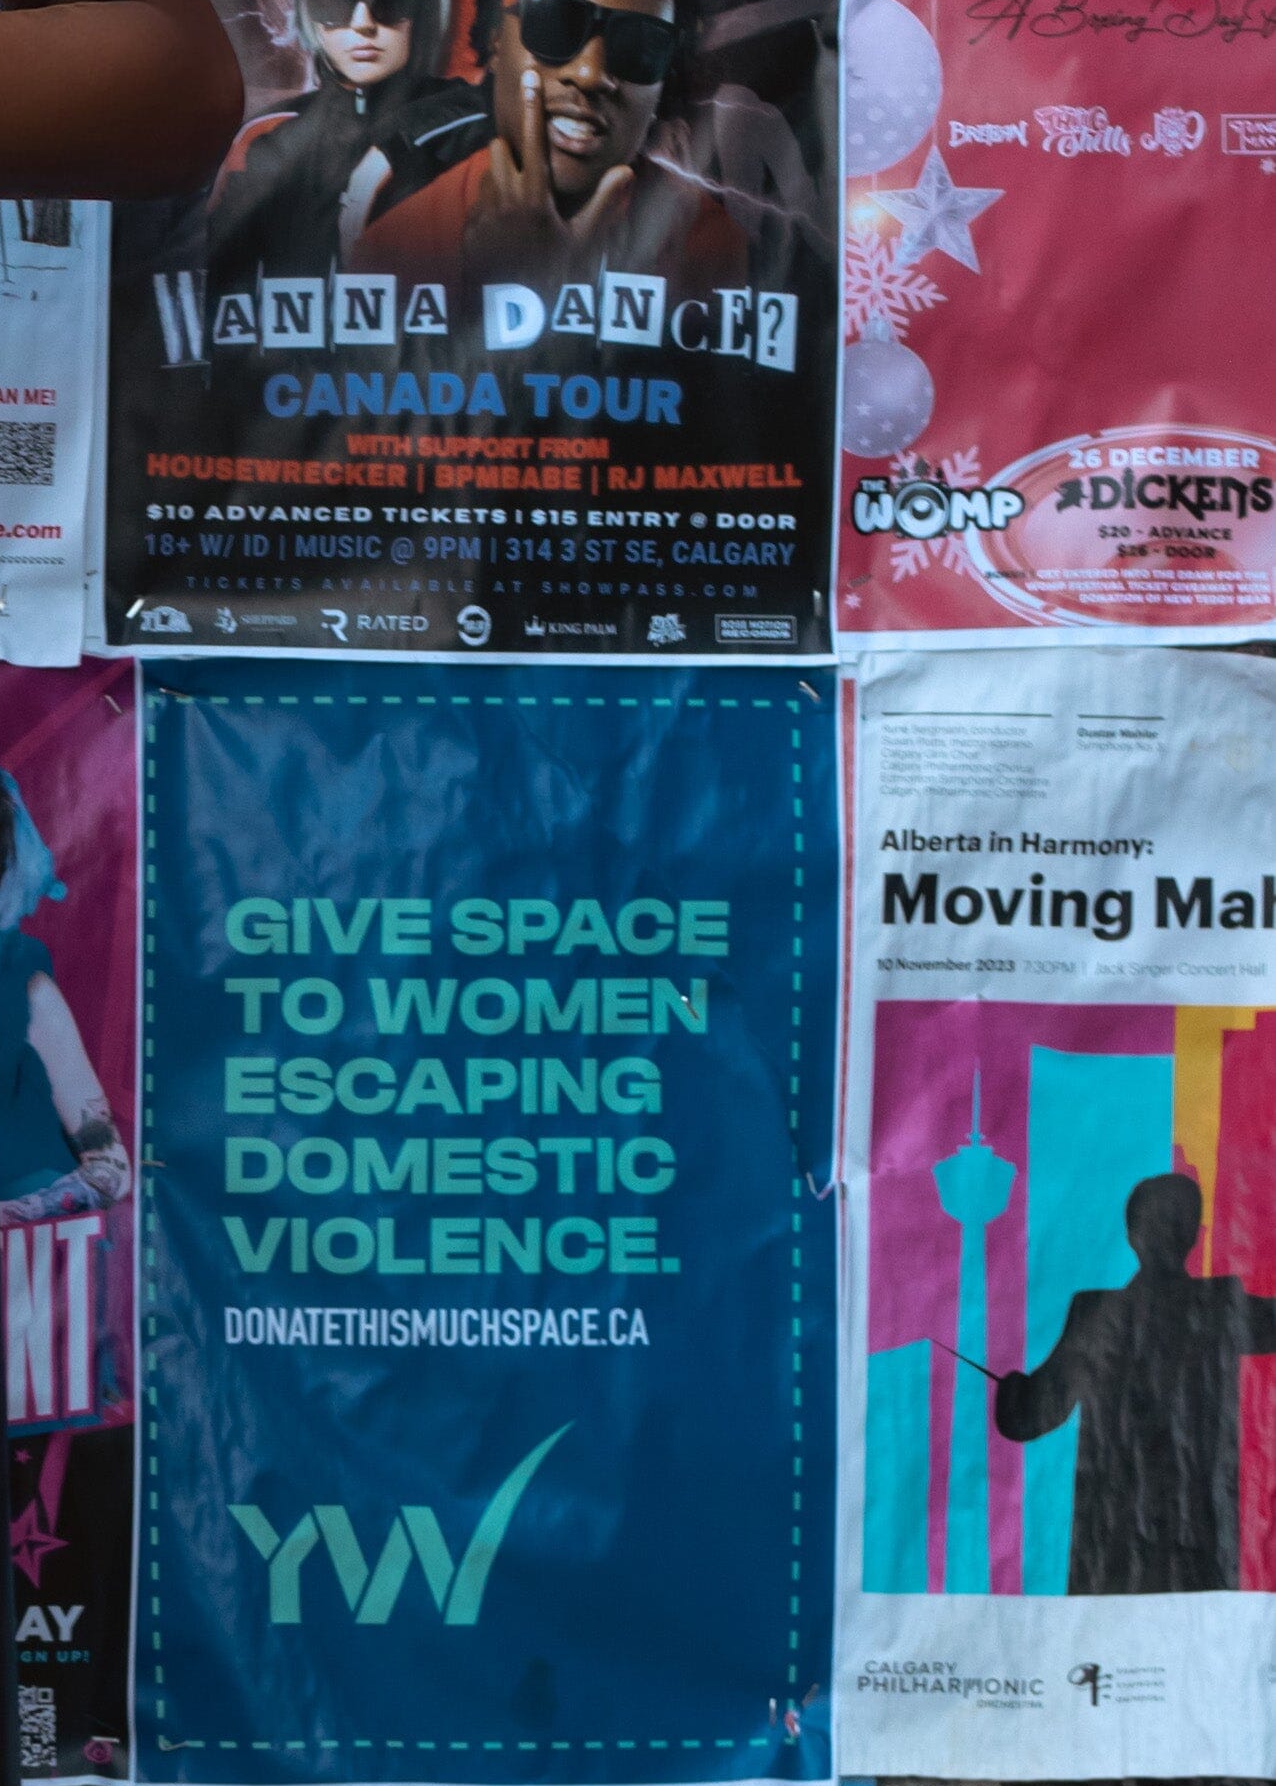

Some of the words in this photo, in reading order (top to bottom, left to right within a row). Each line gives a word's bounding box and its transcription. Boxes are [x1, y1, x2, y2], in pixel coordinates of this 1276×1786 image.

[154, 267, 447, 367] WANNA
[483, 271, 799, 372] DANCE?
[22, 387, 56, 406] ME!
[264, 373, 506, 418] CANADA
[523, 374, 682, 424] TOUR
[147, 454, 407, 487] HOUSEWRECKER
[608, 466, 644, 490] RJ
[654, 465, 802, 488] MAXWELL
[1109, 448, 1259, 468] DECEMBER
[147, 504, 194, 521] $10
[204, 505, 372, 524] ADVANCED
[382, 507, 506, 525] TICKETS
[1090, 468, 1273, 520] DICKENS
[880, 829, 982, 853] Alberta
[990, 830, 1013, 853] in
[1020, 833, 1155, 860] Harmony:
[224, 898, 433, 957] GIVE
[451, 899, 729, 957] SPACE
[882, 872, 1133, 942] Moving
[224, 978, 344, 1034] TO
[368, 978, 709, 1035] WOMEN
[224, 1057, 662, 1115] ESCAPING
[224, 1137, 676, 1195] DOMESTIC
[222, 1217, 681, 1274] VIOLENCE.
[224, 1307, 650, 1346] DONATETHISMUCHSPACE.CA
[857, 1676, 1044, 1698] PHILHARMONIC
[865, 1661, 958, 1675] CALGARY
